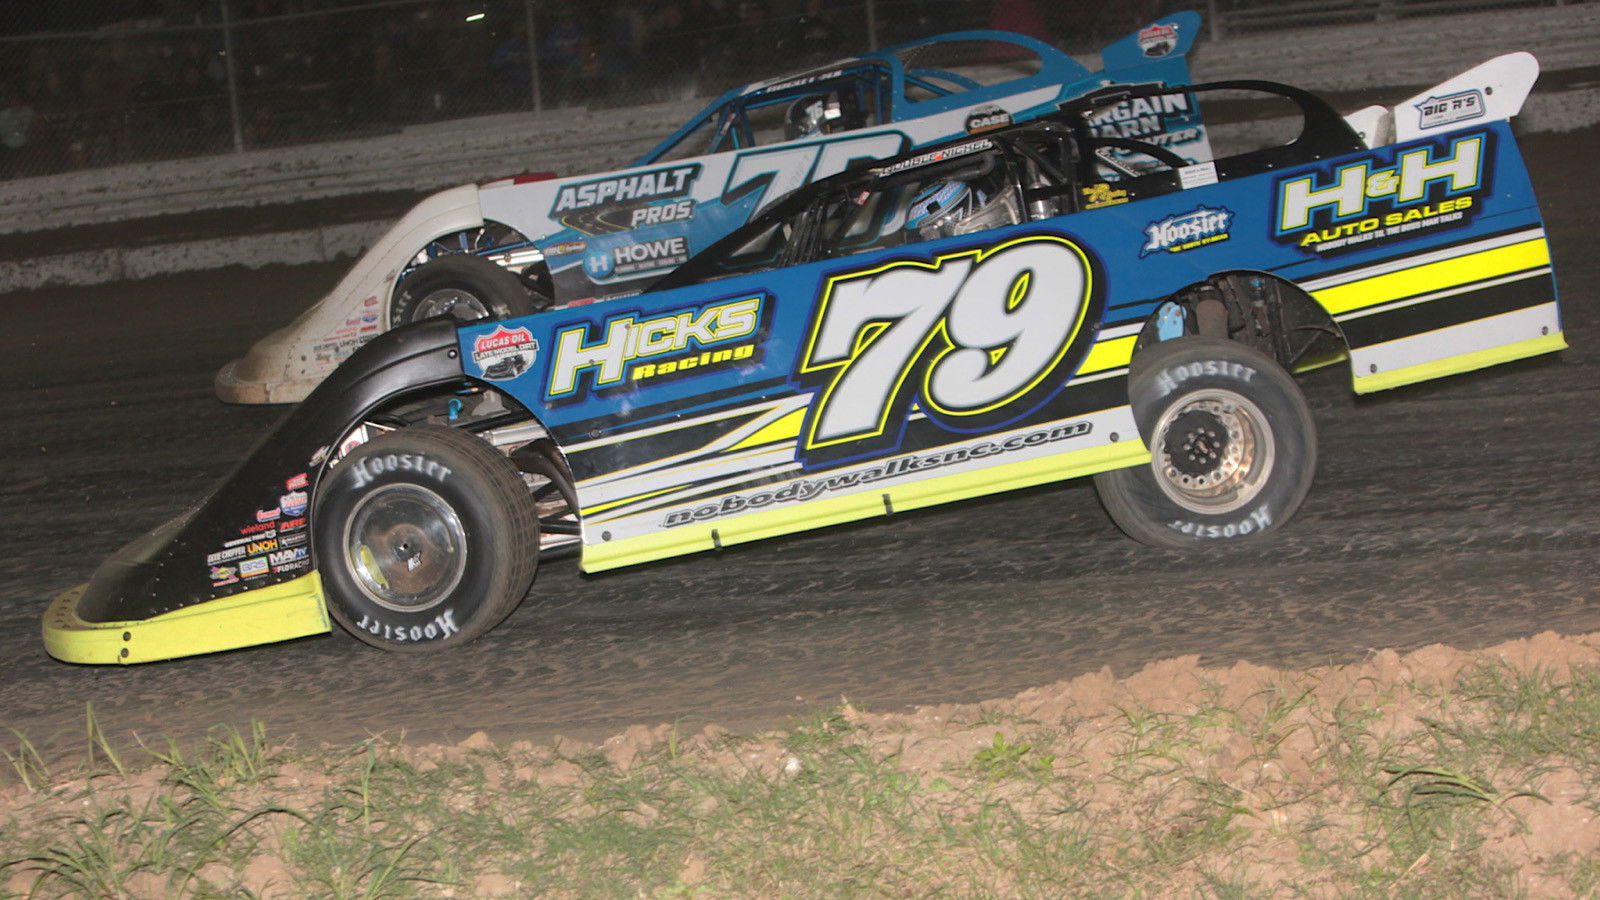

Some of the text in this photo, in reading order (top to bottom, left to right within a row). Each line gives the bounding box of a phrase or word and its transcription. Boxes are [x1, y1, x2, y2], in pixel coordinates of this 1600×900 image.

[969, 113, 1009, 129] CASE
[1090, 115, 1161, 139] ARN
[1423, 102, 1448, 116] BIG
[555, 168, 693, 212] ASPHALT
[1281, 138, 1481, 231] H&H
[630, 201, 692, 229] PROS
[1145, 209, 1229, 251] Hoosier
[1301, 196, 1473, 247] AUTO SALES
[614, 237, 687, 264] HOWE
[481, 333, 526, 349] LUCAS OIL
[803, 237, 1092, 450] 79
[632, 344, 755, 381] Racing
[1154, 360, 1257, 397] Hoosier
[352, 452, 452, 489] Hoosier
[663, 421, 1093, 529] nobodywalksnc.com
[1168, 504, 1272, 539] Hoosier
[247, 539, 279, 554] UNOH
[356, 609, 460, 641] Hoosier
